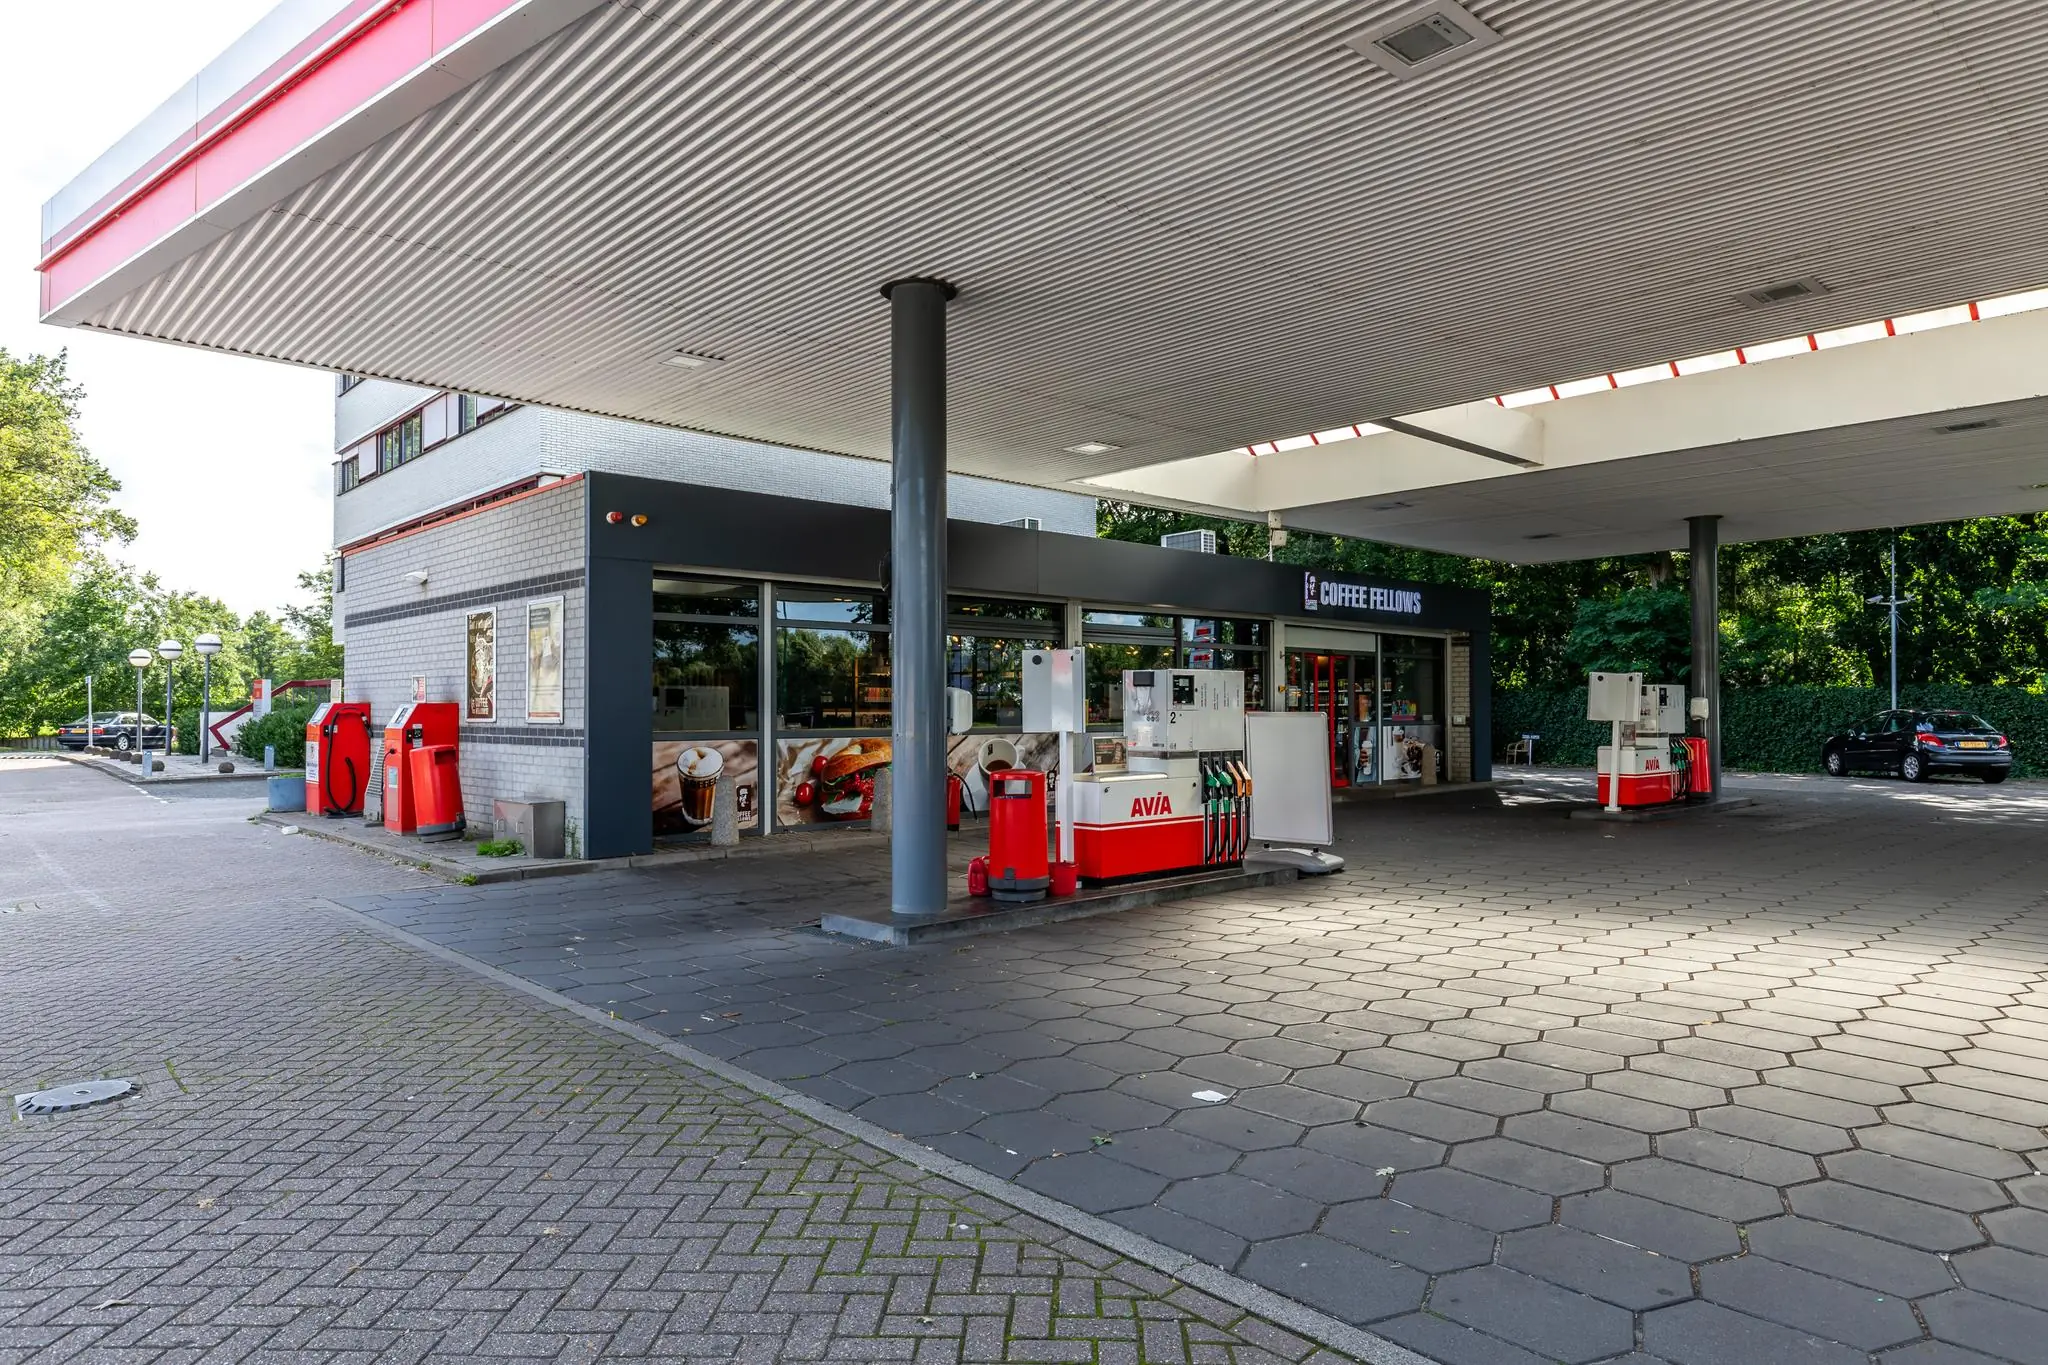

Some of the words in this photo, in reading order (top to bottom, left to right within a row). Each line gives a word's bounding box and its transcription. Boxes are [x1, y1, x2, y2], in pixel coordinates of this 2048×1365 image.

[1320, 581, 1367, 608] COFFEE
[1370, 587, 1421, 615] FELLOWS
[1170, 712, 1176, 724] 2
[1130, 792, 1172, 817] AVIA
